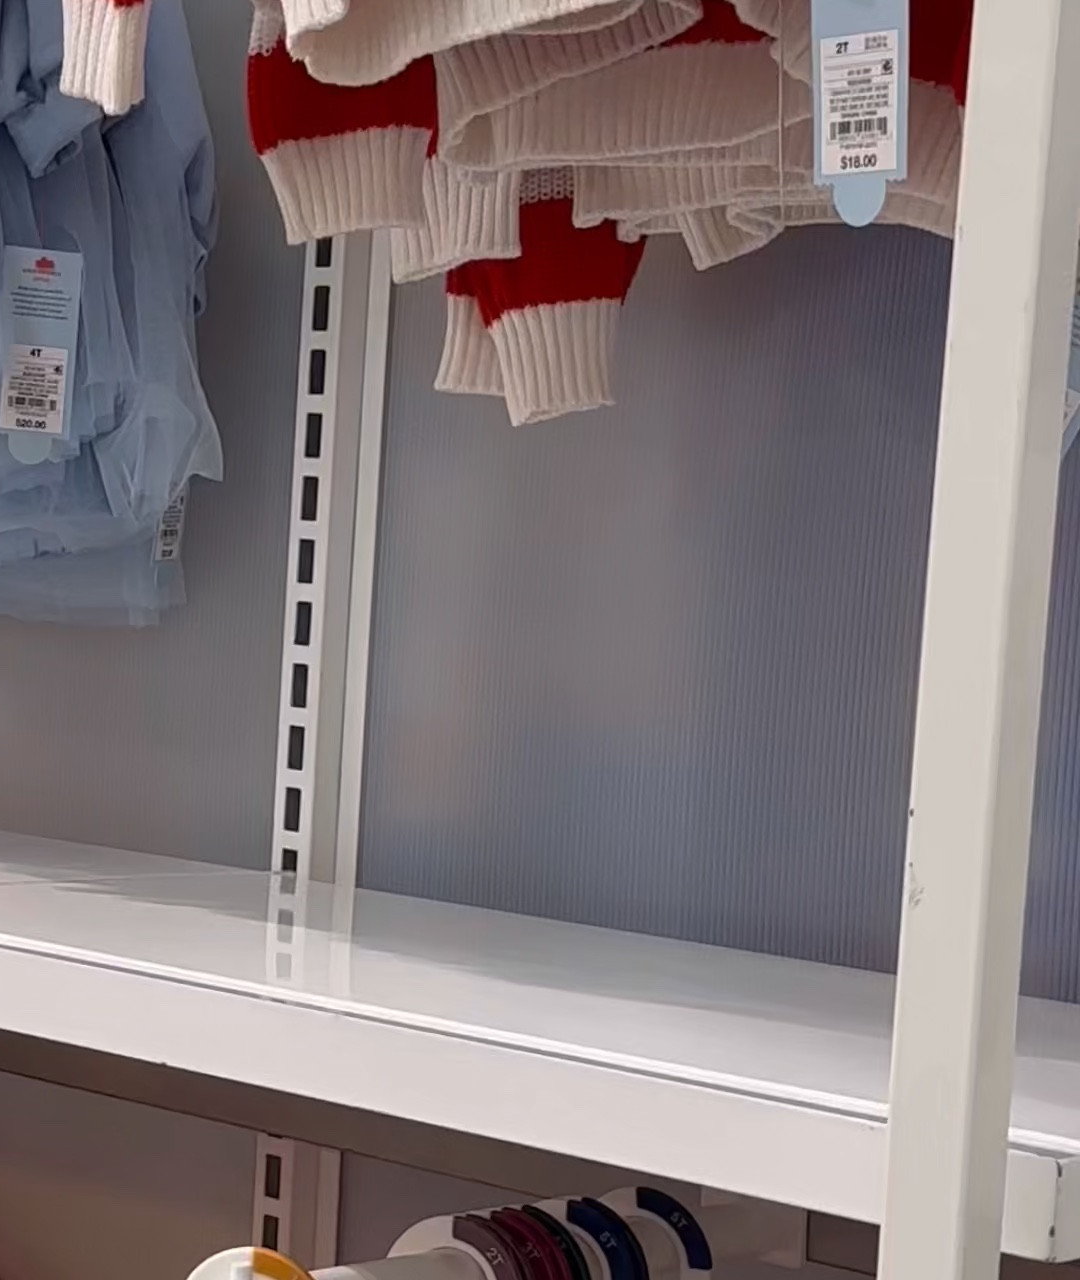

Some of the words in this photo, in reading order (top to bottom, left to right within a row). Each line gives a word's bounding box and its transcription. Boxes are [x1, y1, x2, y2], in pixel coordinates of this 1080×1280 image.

[835, 41, 850, 55] 2T
[839, 152, 878, 171] $18.00
[486, 1246, 505, 1267] 2T
